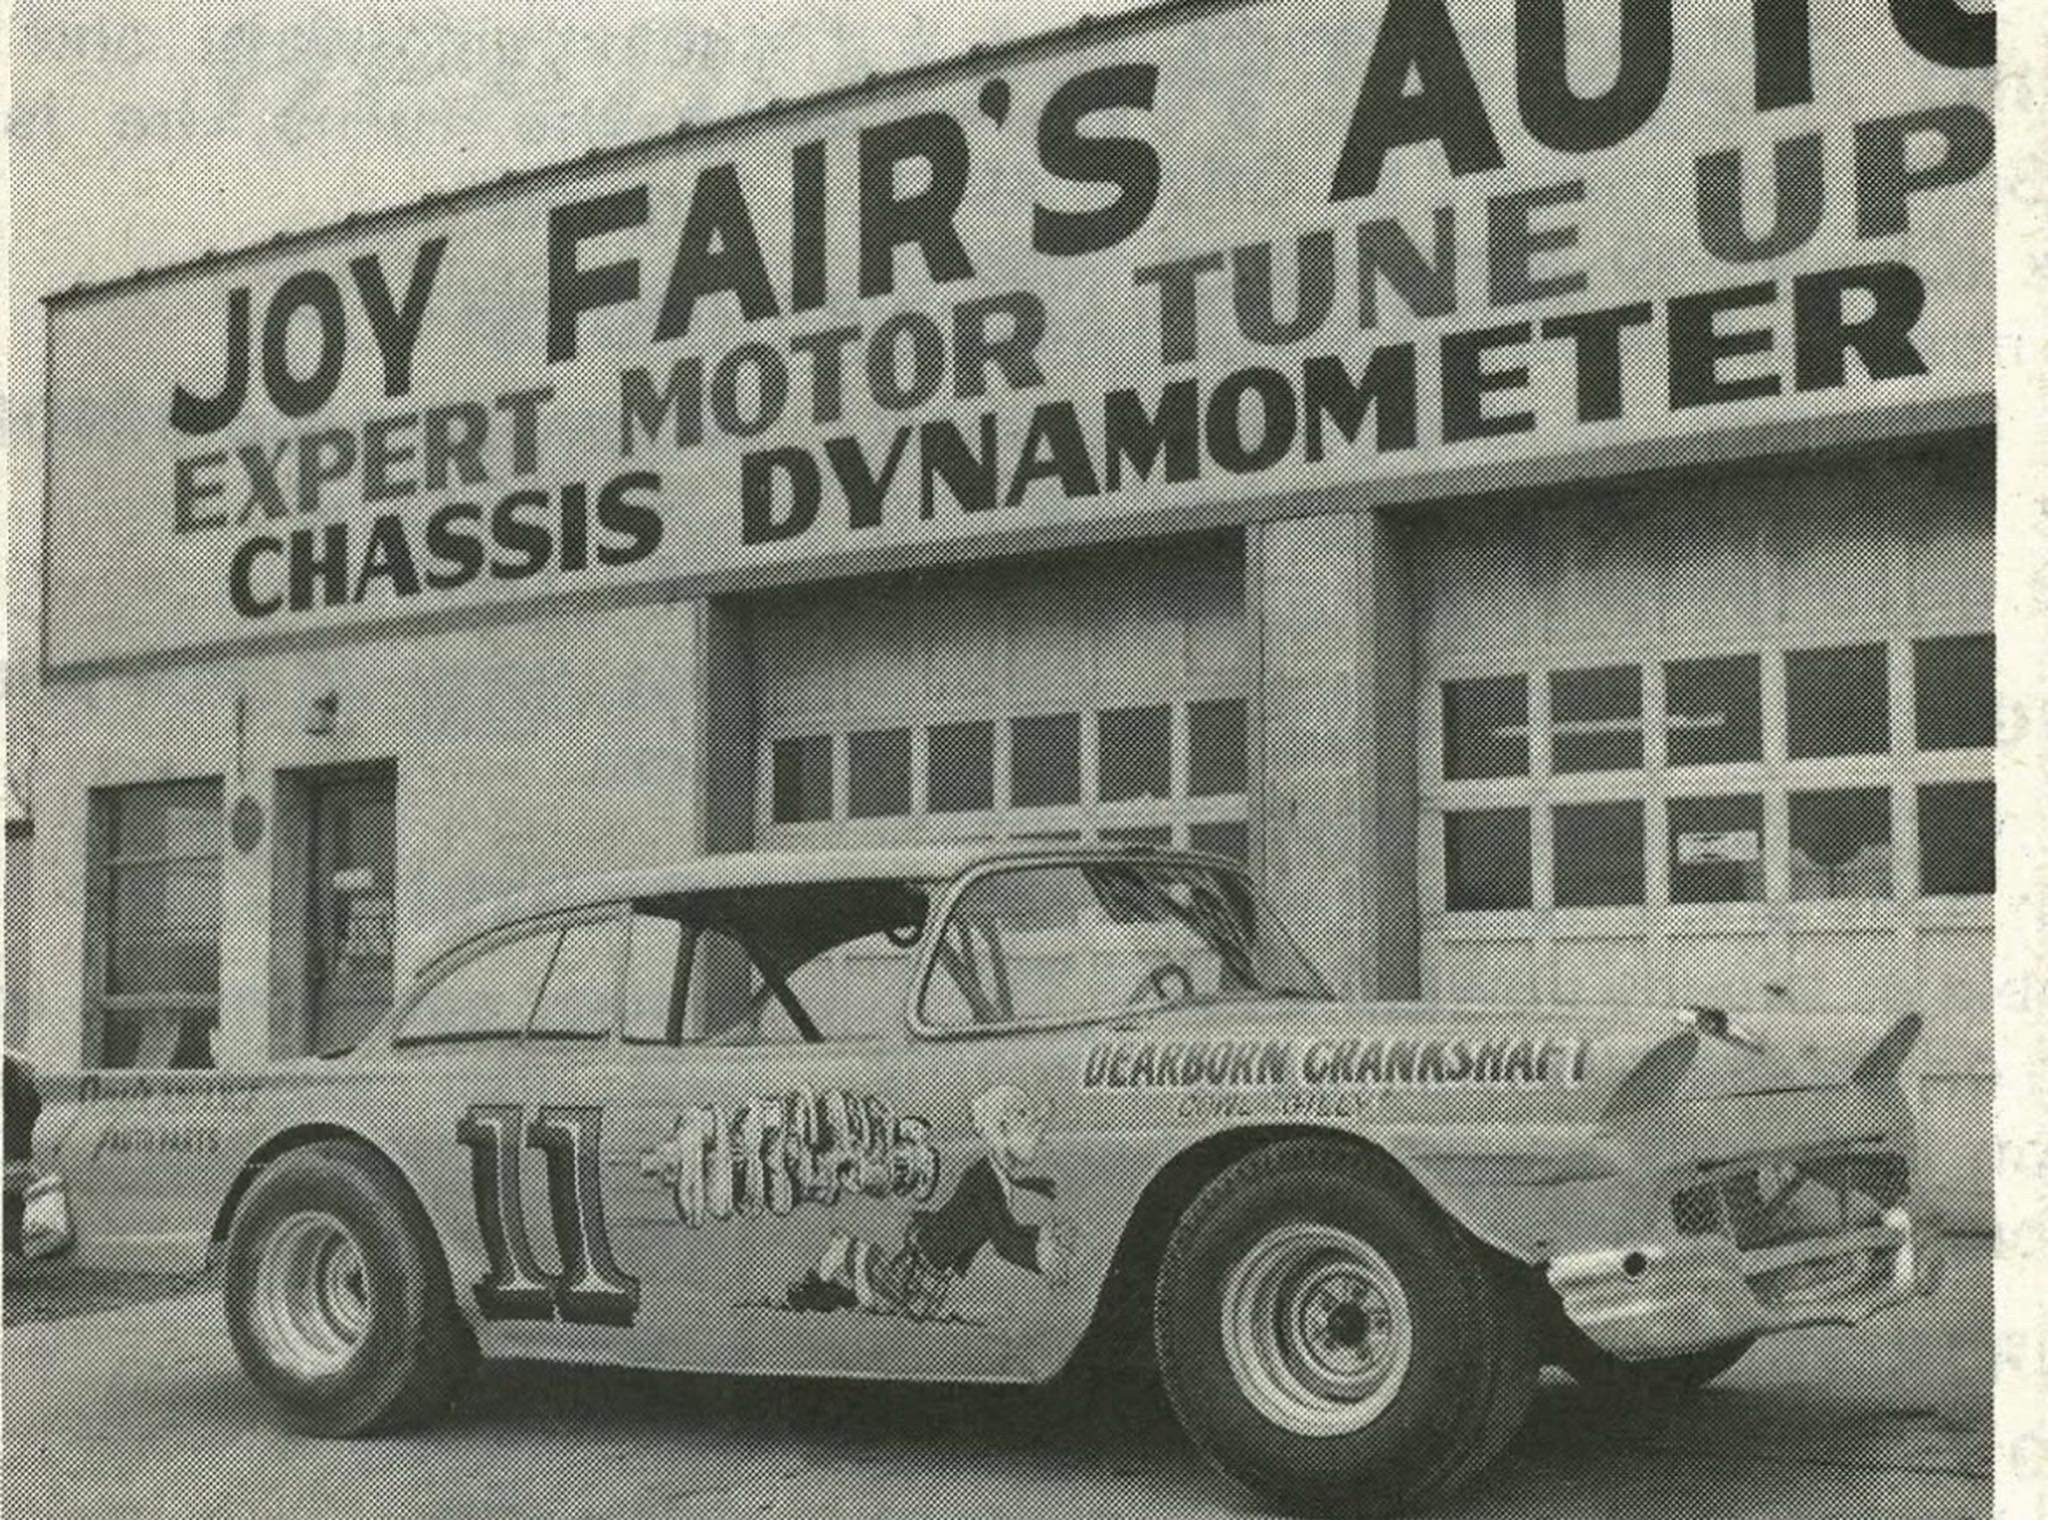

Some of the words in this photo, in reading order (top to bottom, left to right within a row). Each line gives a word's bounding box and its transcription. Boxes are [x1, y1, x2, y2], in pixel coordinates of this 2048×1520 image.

[170, 238, 448, 436] JOY
[547, 62, 1162, 365] FAIR'S
[1329, 0, 1997, 202] AU
[175, 385, 555, 534] EXPERT
[619, 290, 1046, 457] MOTOR
[1134, 179, 1588, 367] TUNE
[1694, 102, 1997, 263] UP
[229, 471, 665, 618] CHASSIS
[740, 260, 1930, 547] DYNAMOMETER
[456, 1104, 641, 1328] 11
[1084, 1036, 1293, 1090] DEARBORN
[1302, 1034, 1590, 1087] CRANKSHAFT
